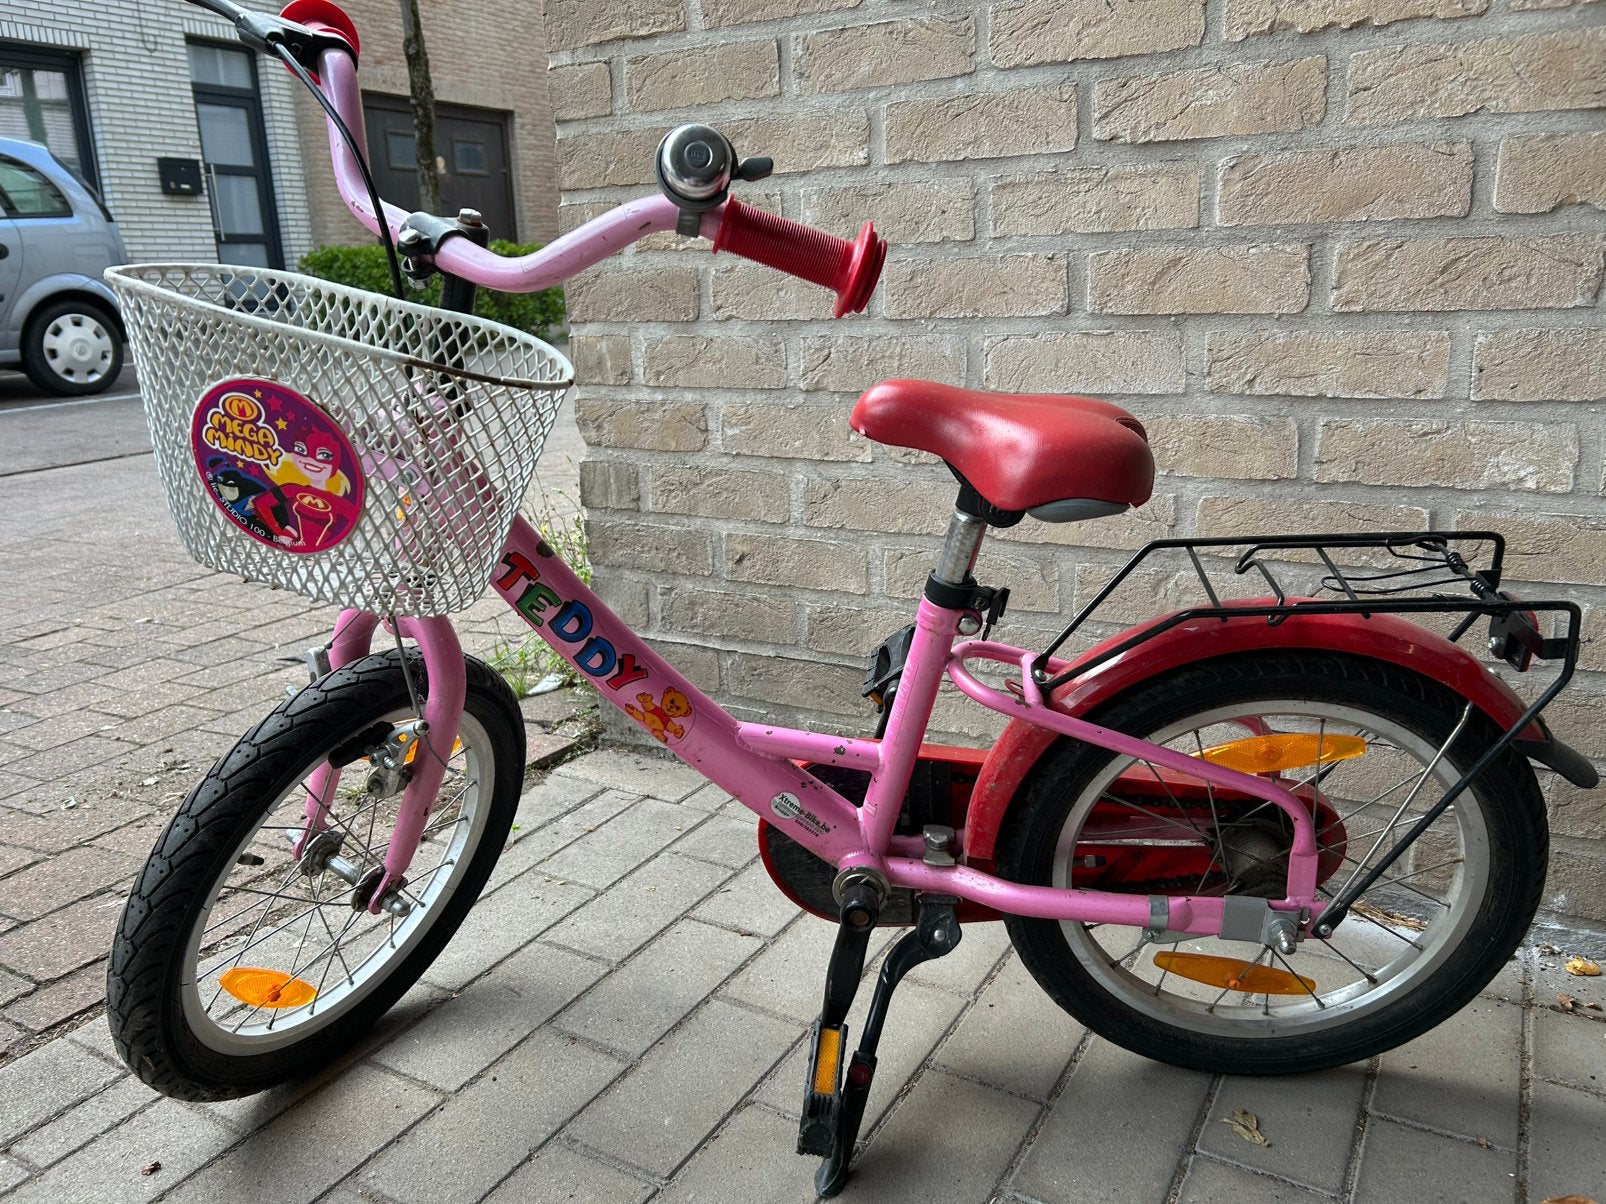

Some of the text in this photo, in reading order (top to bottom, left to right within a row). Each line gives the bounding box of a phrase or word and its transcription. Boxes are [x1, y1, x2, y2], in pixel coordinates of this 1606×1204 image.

[231, 399, 252, 418] M
[212, 413, 275, 446] MEGA
[219, 496, 248, 525] STUDIO
[249, 523, 266, 537] 100
[496, 551, 649, 691] TEDDY
[779, 793, 831, 833] Xtreme-Bike.be
